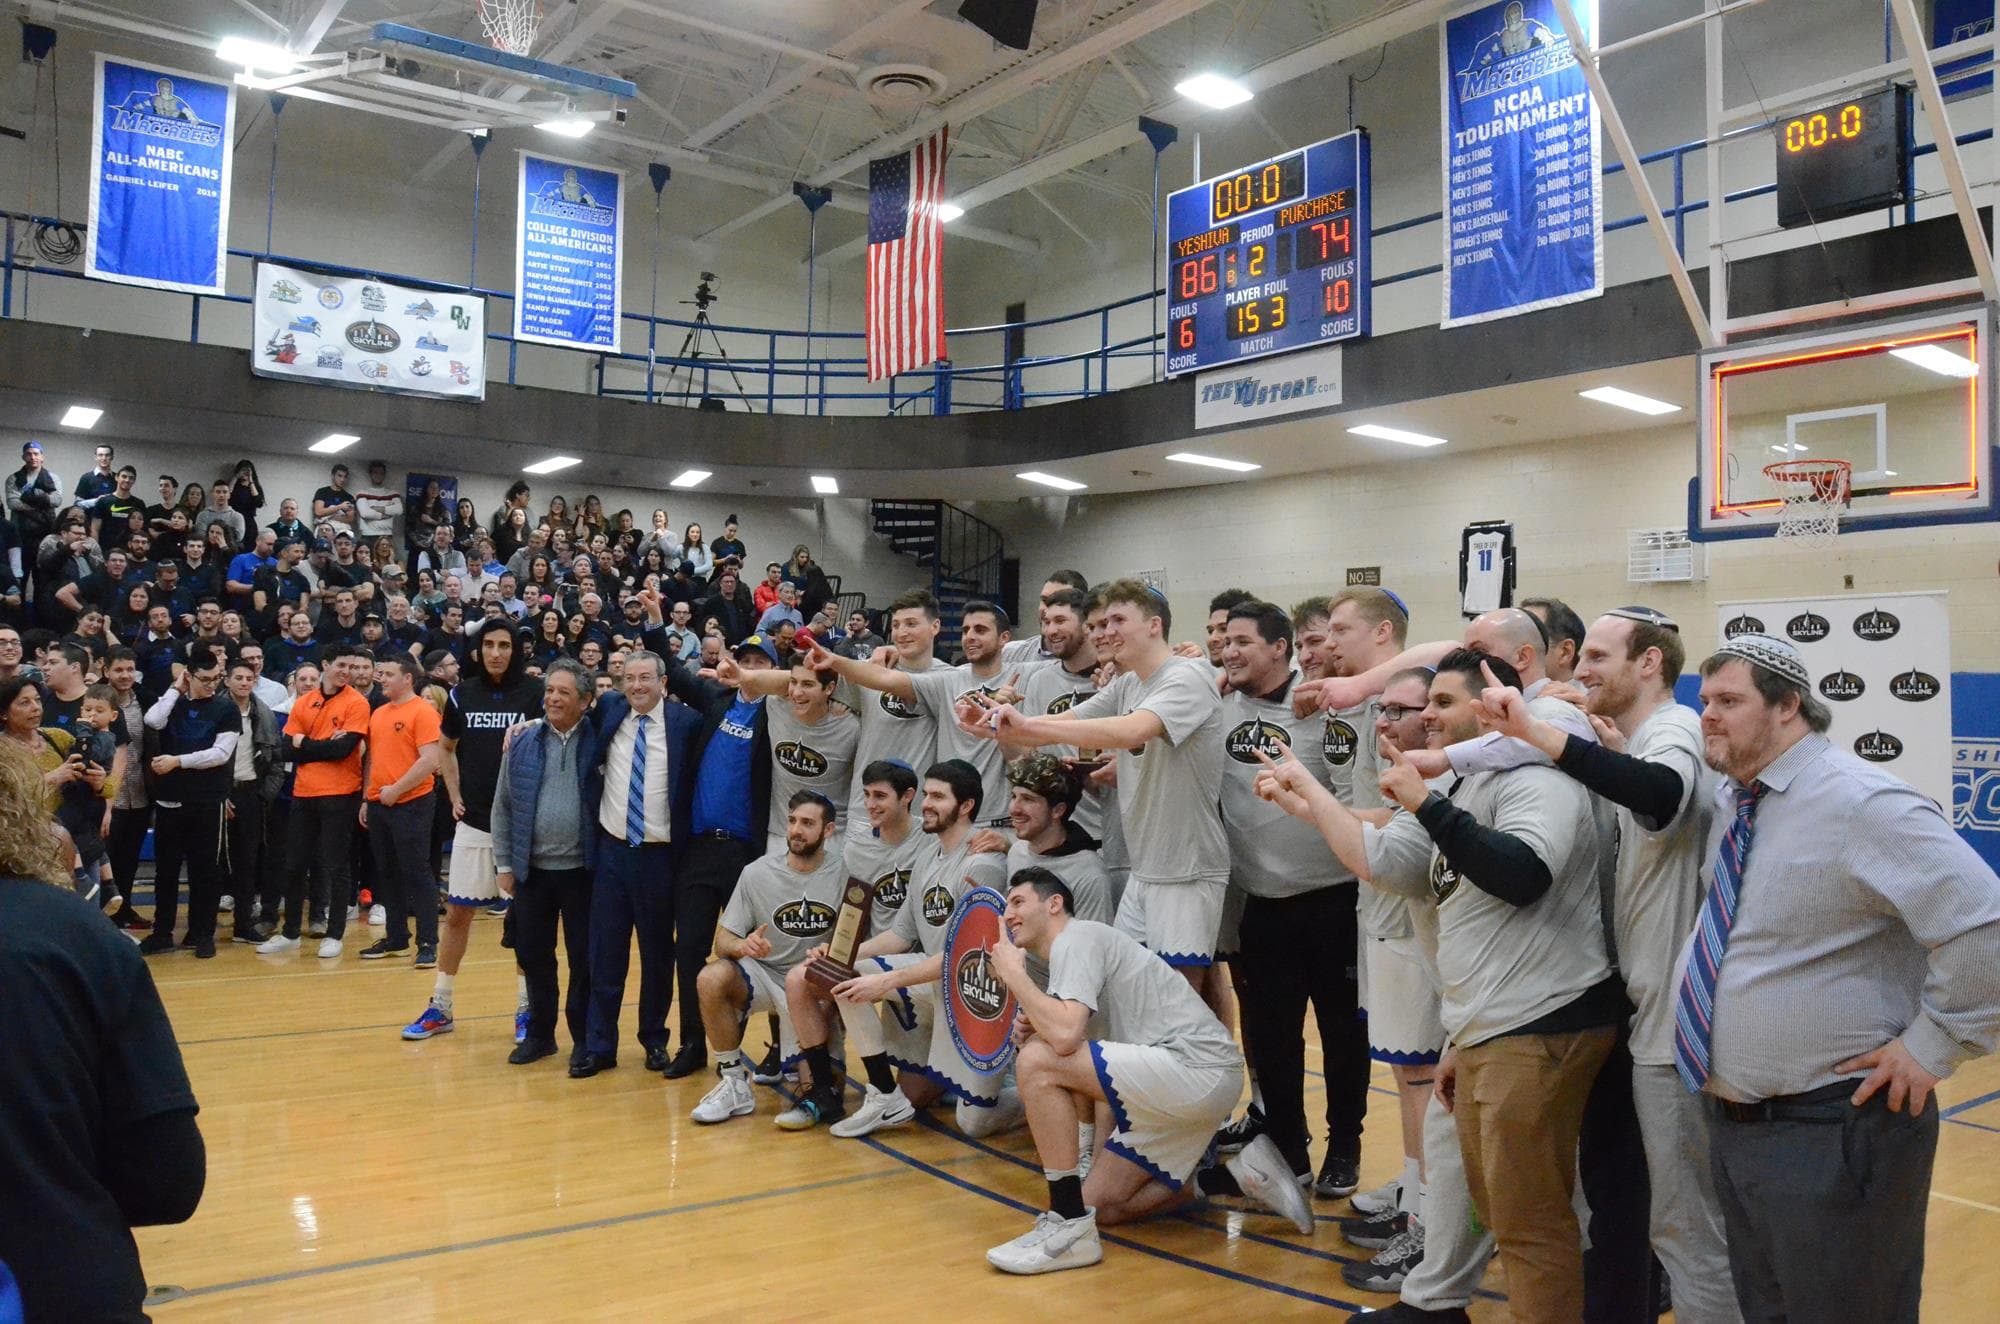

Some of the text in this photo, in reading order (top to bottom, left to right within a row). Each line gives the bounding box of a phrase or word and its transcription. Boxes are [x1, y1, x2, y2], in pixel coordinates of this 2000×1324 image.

[1459, 46, 1578, 103] MACCABEES
[1494, 86, 1544, 117] NCAA
[110, 107, 221, 147] MACCABEES
[1455, 93, 1586, 148] TOURNAMENT
[1786, 104, 1861, 152] 00.0
[146, 144, 184, 161] NABC
[107, 151, 219, 180] ALL-AMERICANS
[105, 173, 217, 198] GABRIEL LEIFER 2019
[530, 195, 613, 227] MACCABEES
[1280, 191, 1346, 227] PURCHASE
[527, 221, 613, 244] COLLEGE DIVISION
[527, 232, 613, 254] ALL-AMERICANS
[1177, 227, 1230, 257] YESHIVA
[1240, 223, 1274, 245] PERIOD
[1311, 218, 1349, 259] 74
[550, 264, 570, 273] STEIN
[1251, 245, 1264, 276] 2
[1182, 255, 1218, 299] 86
[1321, 262, 1354, 282] FOULS
[1226, 279, 1288, 306] PLAYER FOUL
[1325, 280, 1350, 312] 10
[526, 303, 549, 312] SANDY
[1170, 302, 1198, 320] FOULS
[1272, 296, 1285, 327] 3
[1180, 319, 1194, 348] 6
[1320, 318, 1354, 337] SCORE
[352, 336, 394, 348] SKYLINE
[1241, 336, 1273, 355] MATCH
[1169, 353, 1197, 370] SCORE
[1478, 550, 1492, 571] 11
[1349, 572, 1364, 583] NO
[465, 712, 526, 728] YESHIVA
[719, 718, 753, 739] MACCAB
[1324, 745, 1350, 753] SKYLINE
[1861, 748, 1896, 756] SKYLINE
[780, 756, 820, 774] SKYLINE
[882, 890, 906, 903] SKYL
[925, 908, 948, 918] SKYLINE
[782, 921, 828, 929] SKYLINE
[963, 983, 999, 1008] SKYLINE
